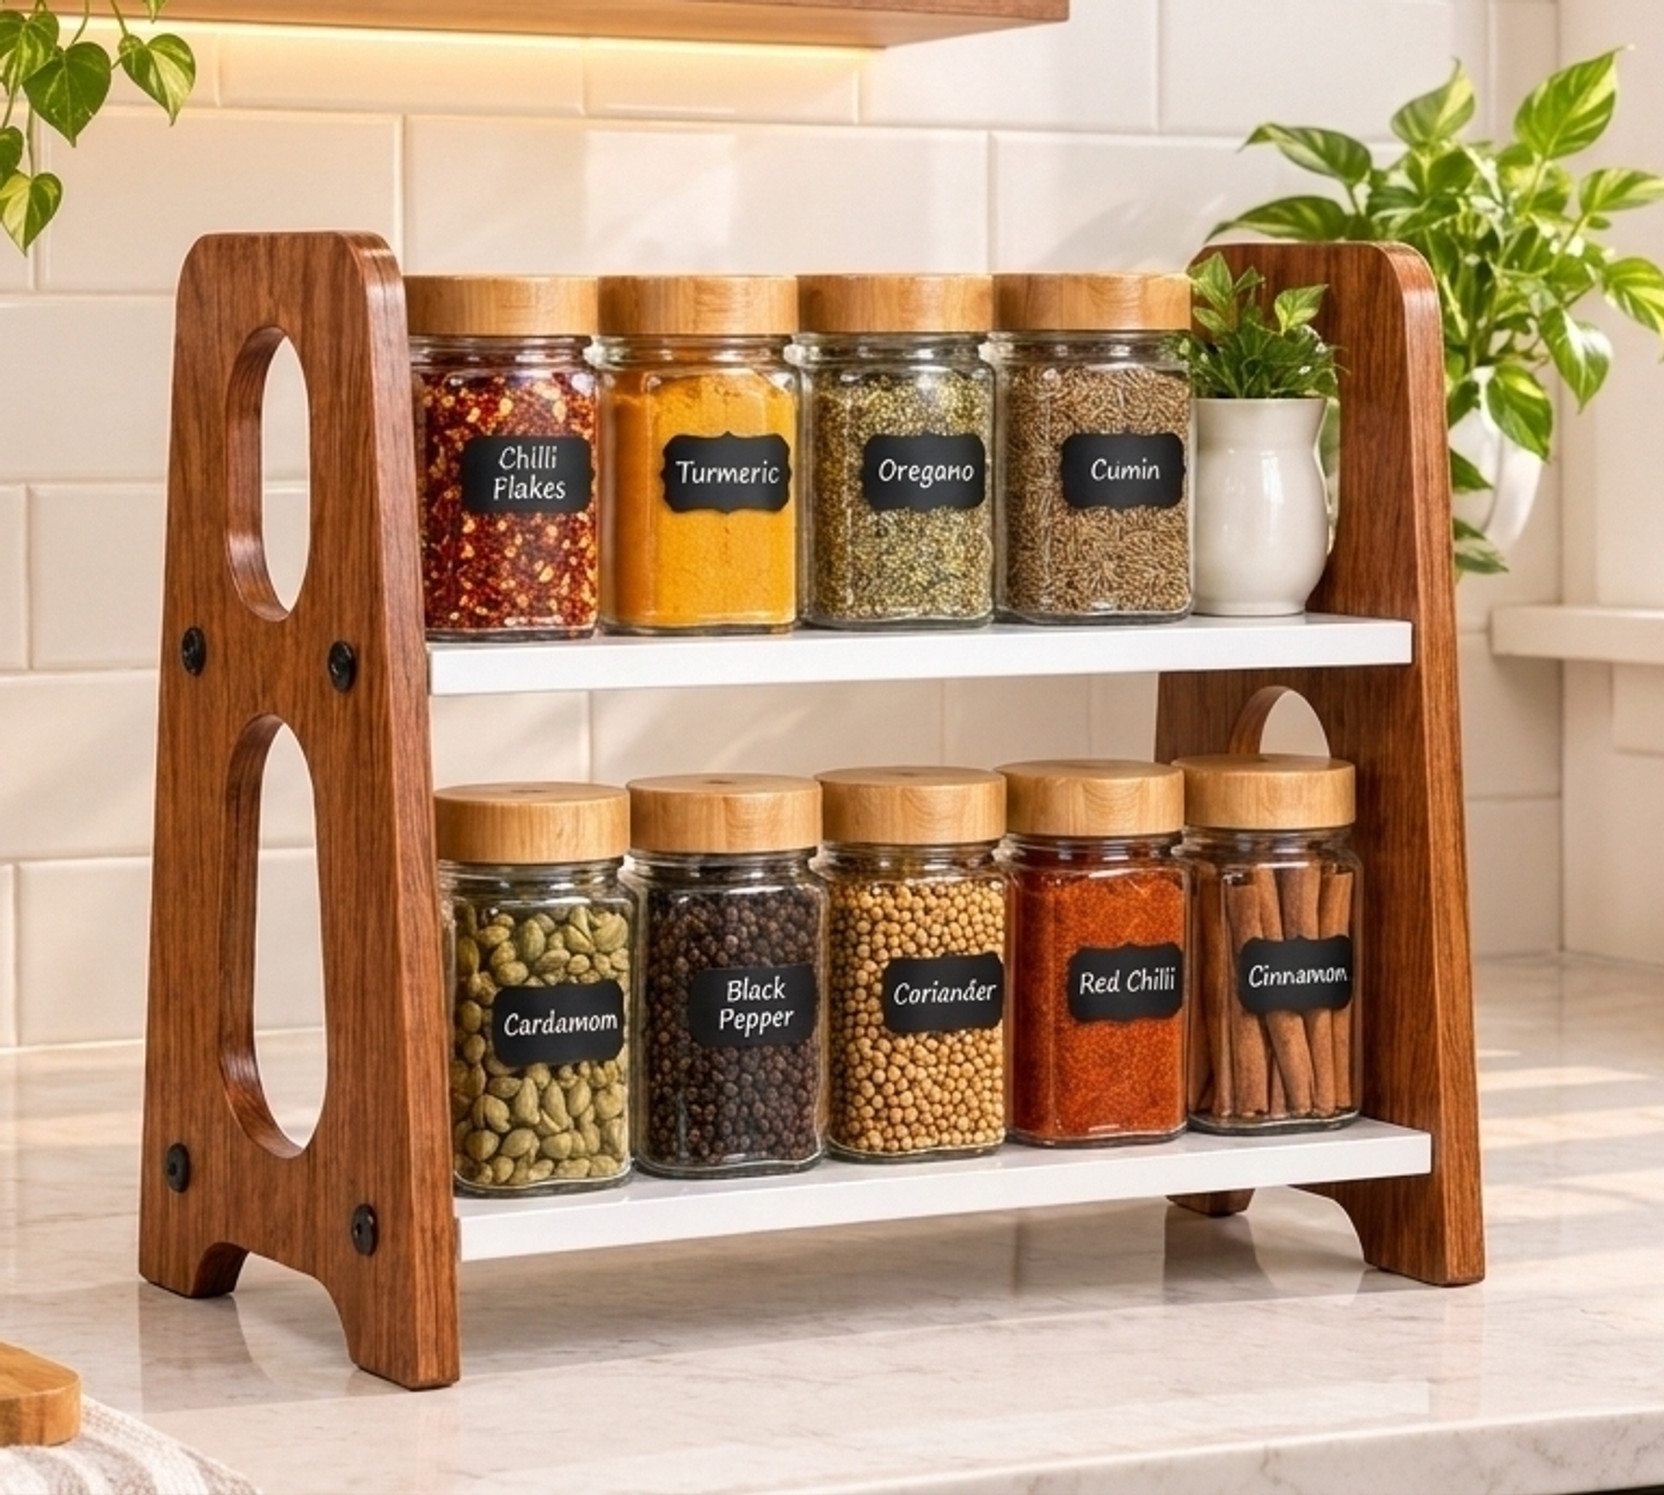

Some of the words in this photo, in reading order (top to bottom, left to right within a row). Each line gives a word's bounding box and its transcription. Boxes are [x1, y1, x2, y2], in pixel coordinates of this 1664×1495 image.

[499, 445, 558, 471] Chilli
[676, 459, 779, 484] Turmeric
[1090, 458, 1160, 481] Cumin
[878, 458, 974, 488] Oregano
[493, 474, 566, 501] Flakes
[726, 976, 786, 1003] Black
[893, 978, 997, 1006] Coriander
[1079, 969, 1121, 995] Red
[504, 1009, 618, 1037] Cardamom
[719, 1008, 795, 1037] Pepper
